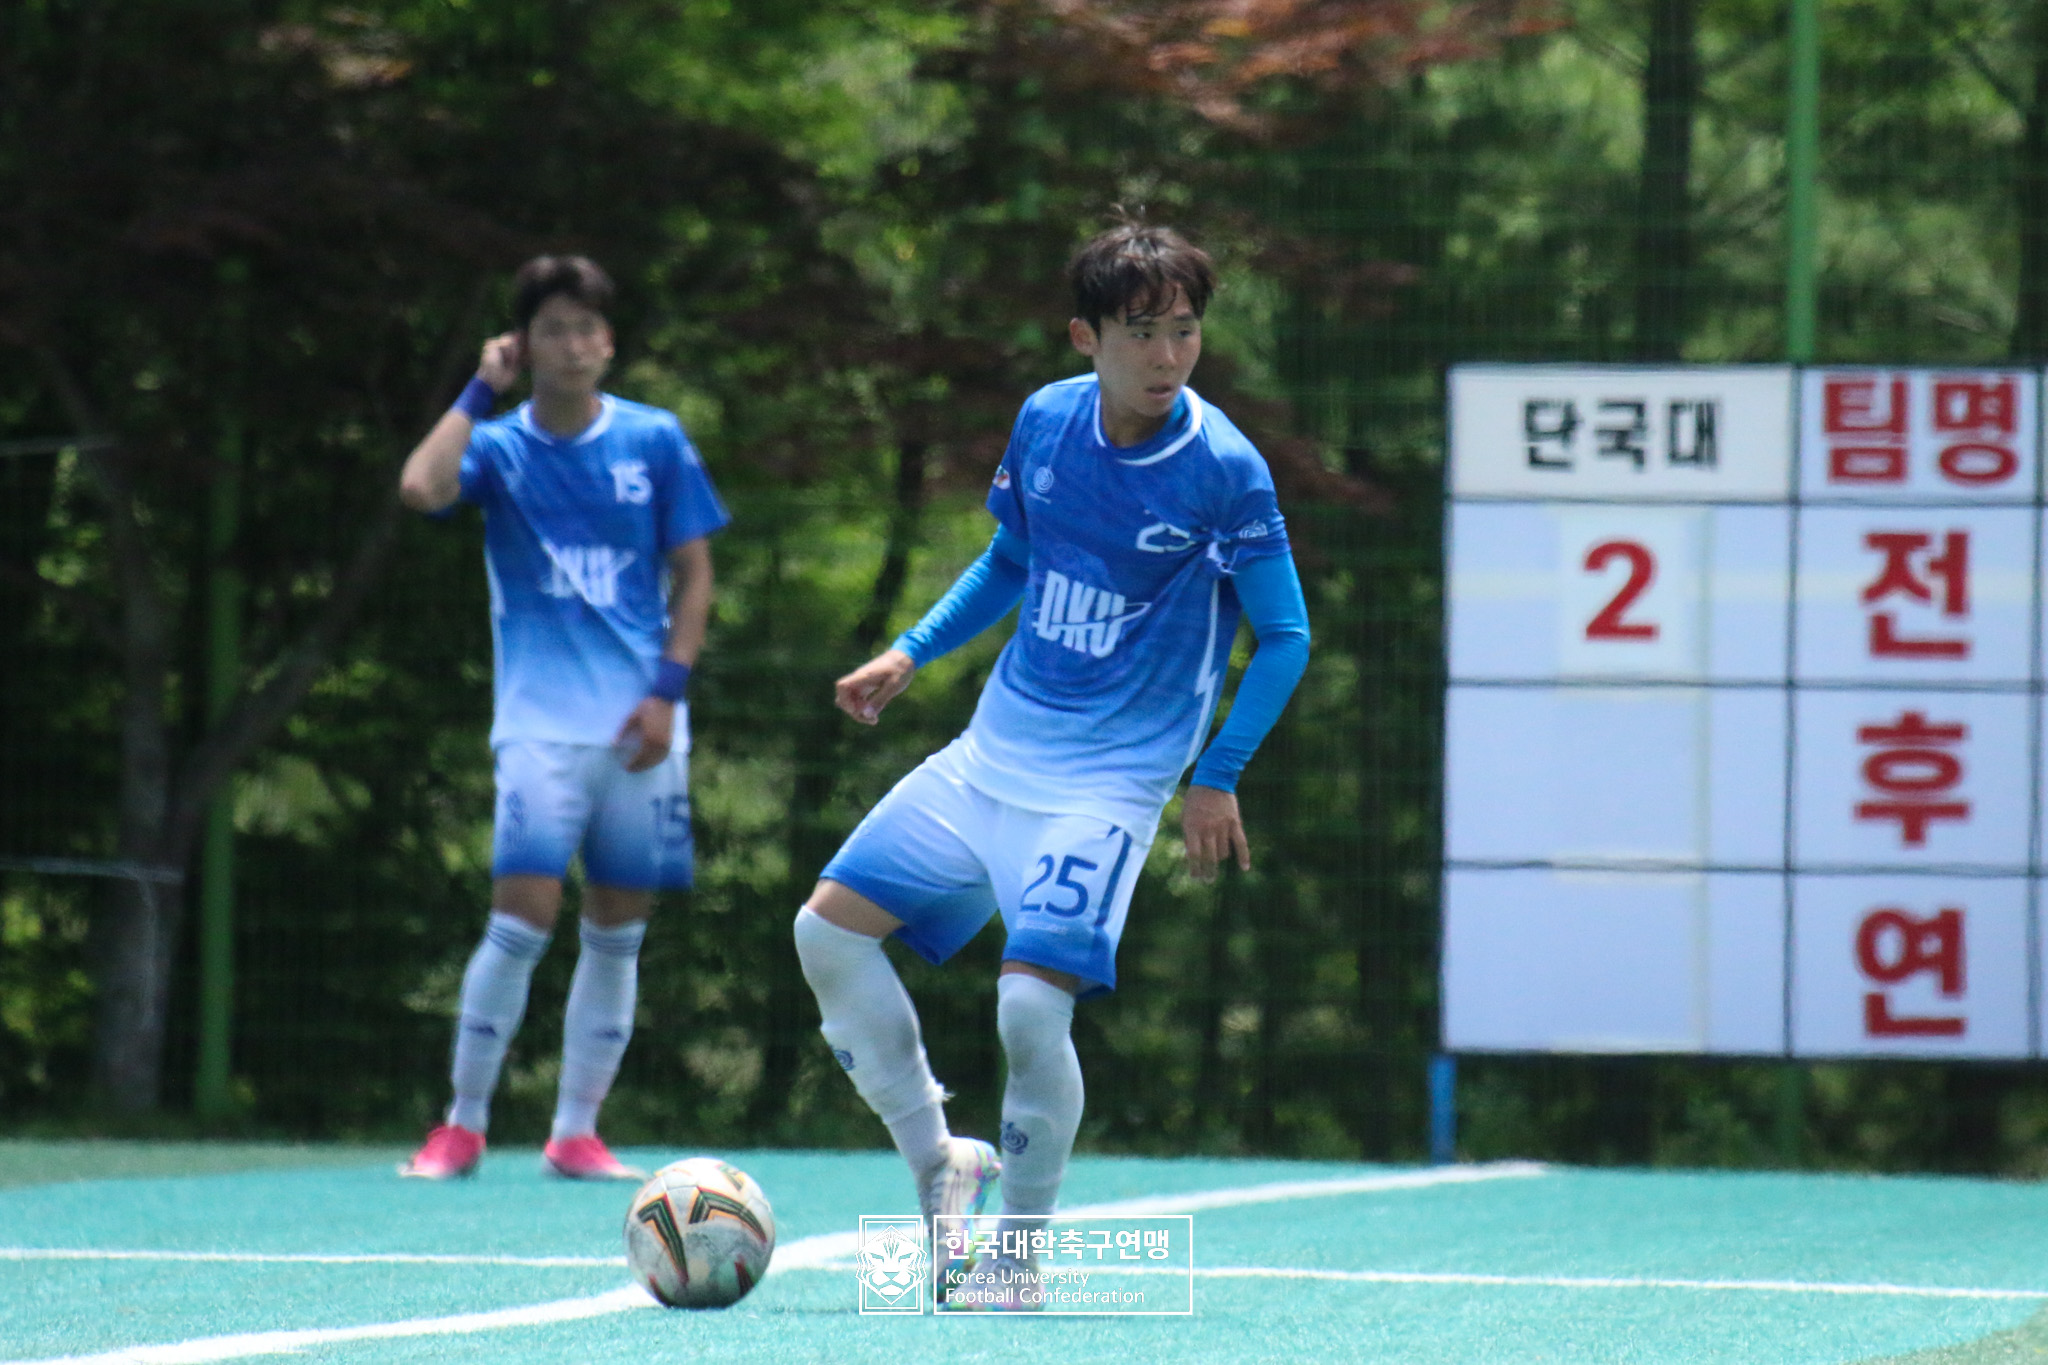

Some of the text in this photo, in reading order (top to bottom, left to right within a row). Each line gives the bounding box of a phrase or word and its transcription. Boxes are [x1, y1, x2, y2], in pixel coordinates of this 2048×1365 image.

[1524, 397, 1718, 472] 단국대
[1822, 373, 2019, 486] 팀명
[610, 459, 653, 505] 15
[1033, 569, 1128, 659] DKU
[1582, 537, 1660, 642] 2
[1859, 530, 1971, 661] 전
[652, 794, 692, 848] 15
[1853, 710, 1971, 847] 후
[1020, 853, 1099, 919] 25
[1855, 906, 1966, 1039] 연
